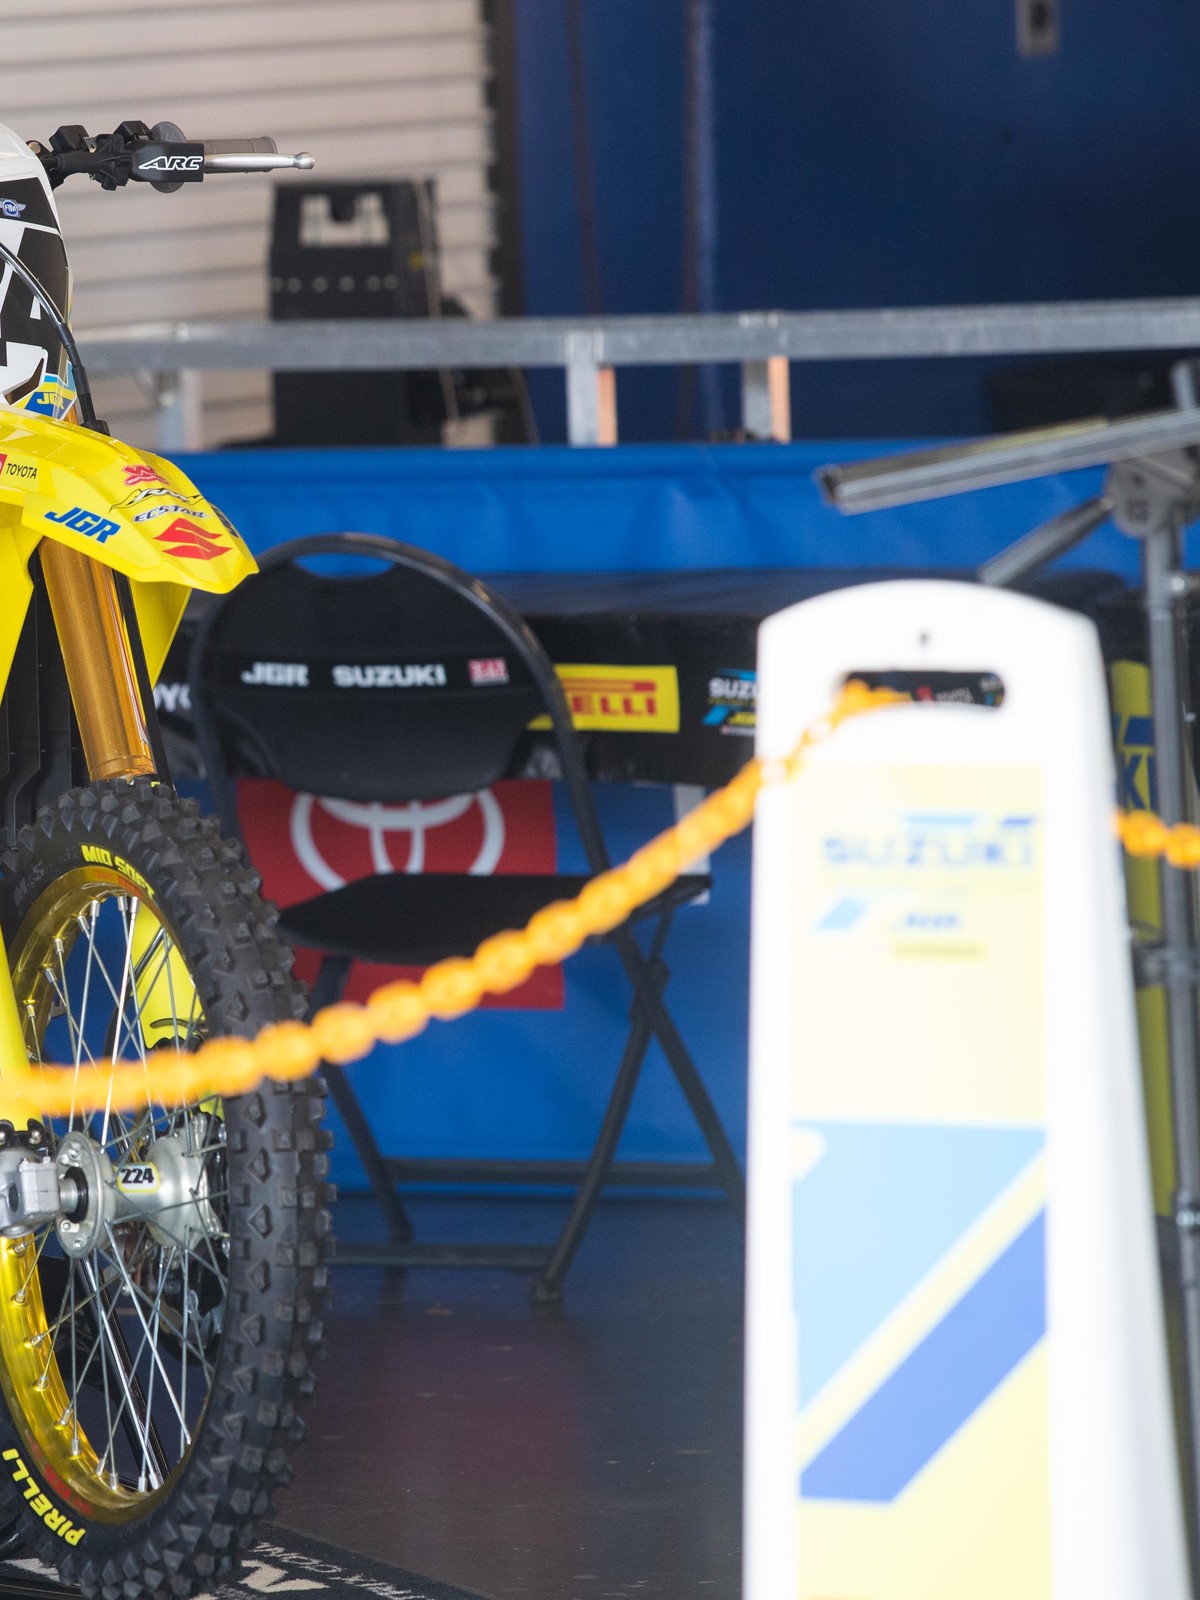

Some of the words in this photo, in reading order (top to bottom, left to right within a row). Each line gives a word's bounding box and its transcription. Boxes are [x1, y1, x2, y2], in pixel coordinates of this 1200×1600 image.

[139, 156, 203, 170] ARC
[36, 392, 64, 409] JGR
[6, 462, 38, 480] TOYOTA
[132, 505, 211, 523] ECSTAR
[44, 507, 121, 544] JGR
[242, 662, 308, 687] JGR
[332, 664, 447, 687] SUZUKI
[81, 845, 113, 867] MID
[115, 856, 155, 897] SOFT
[121, 1168, 154, 1183] 224
[2, 1448, 86, 1547] PIRELLI
